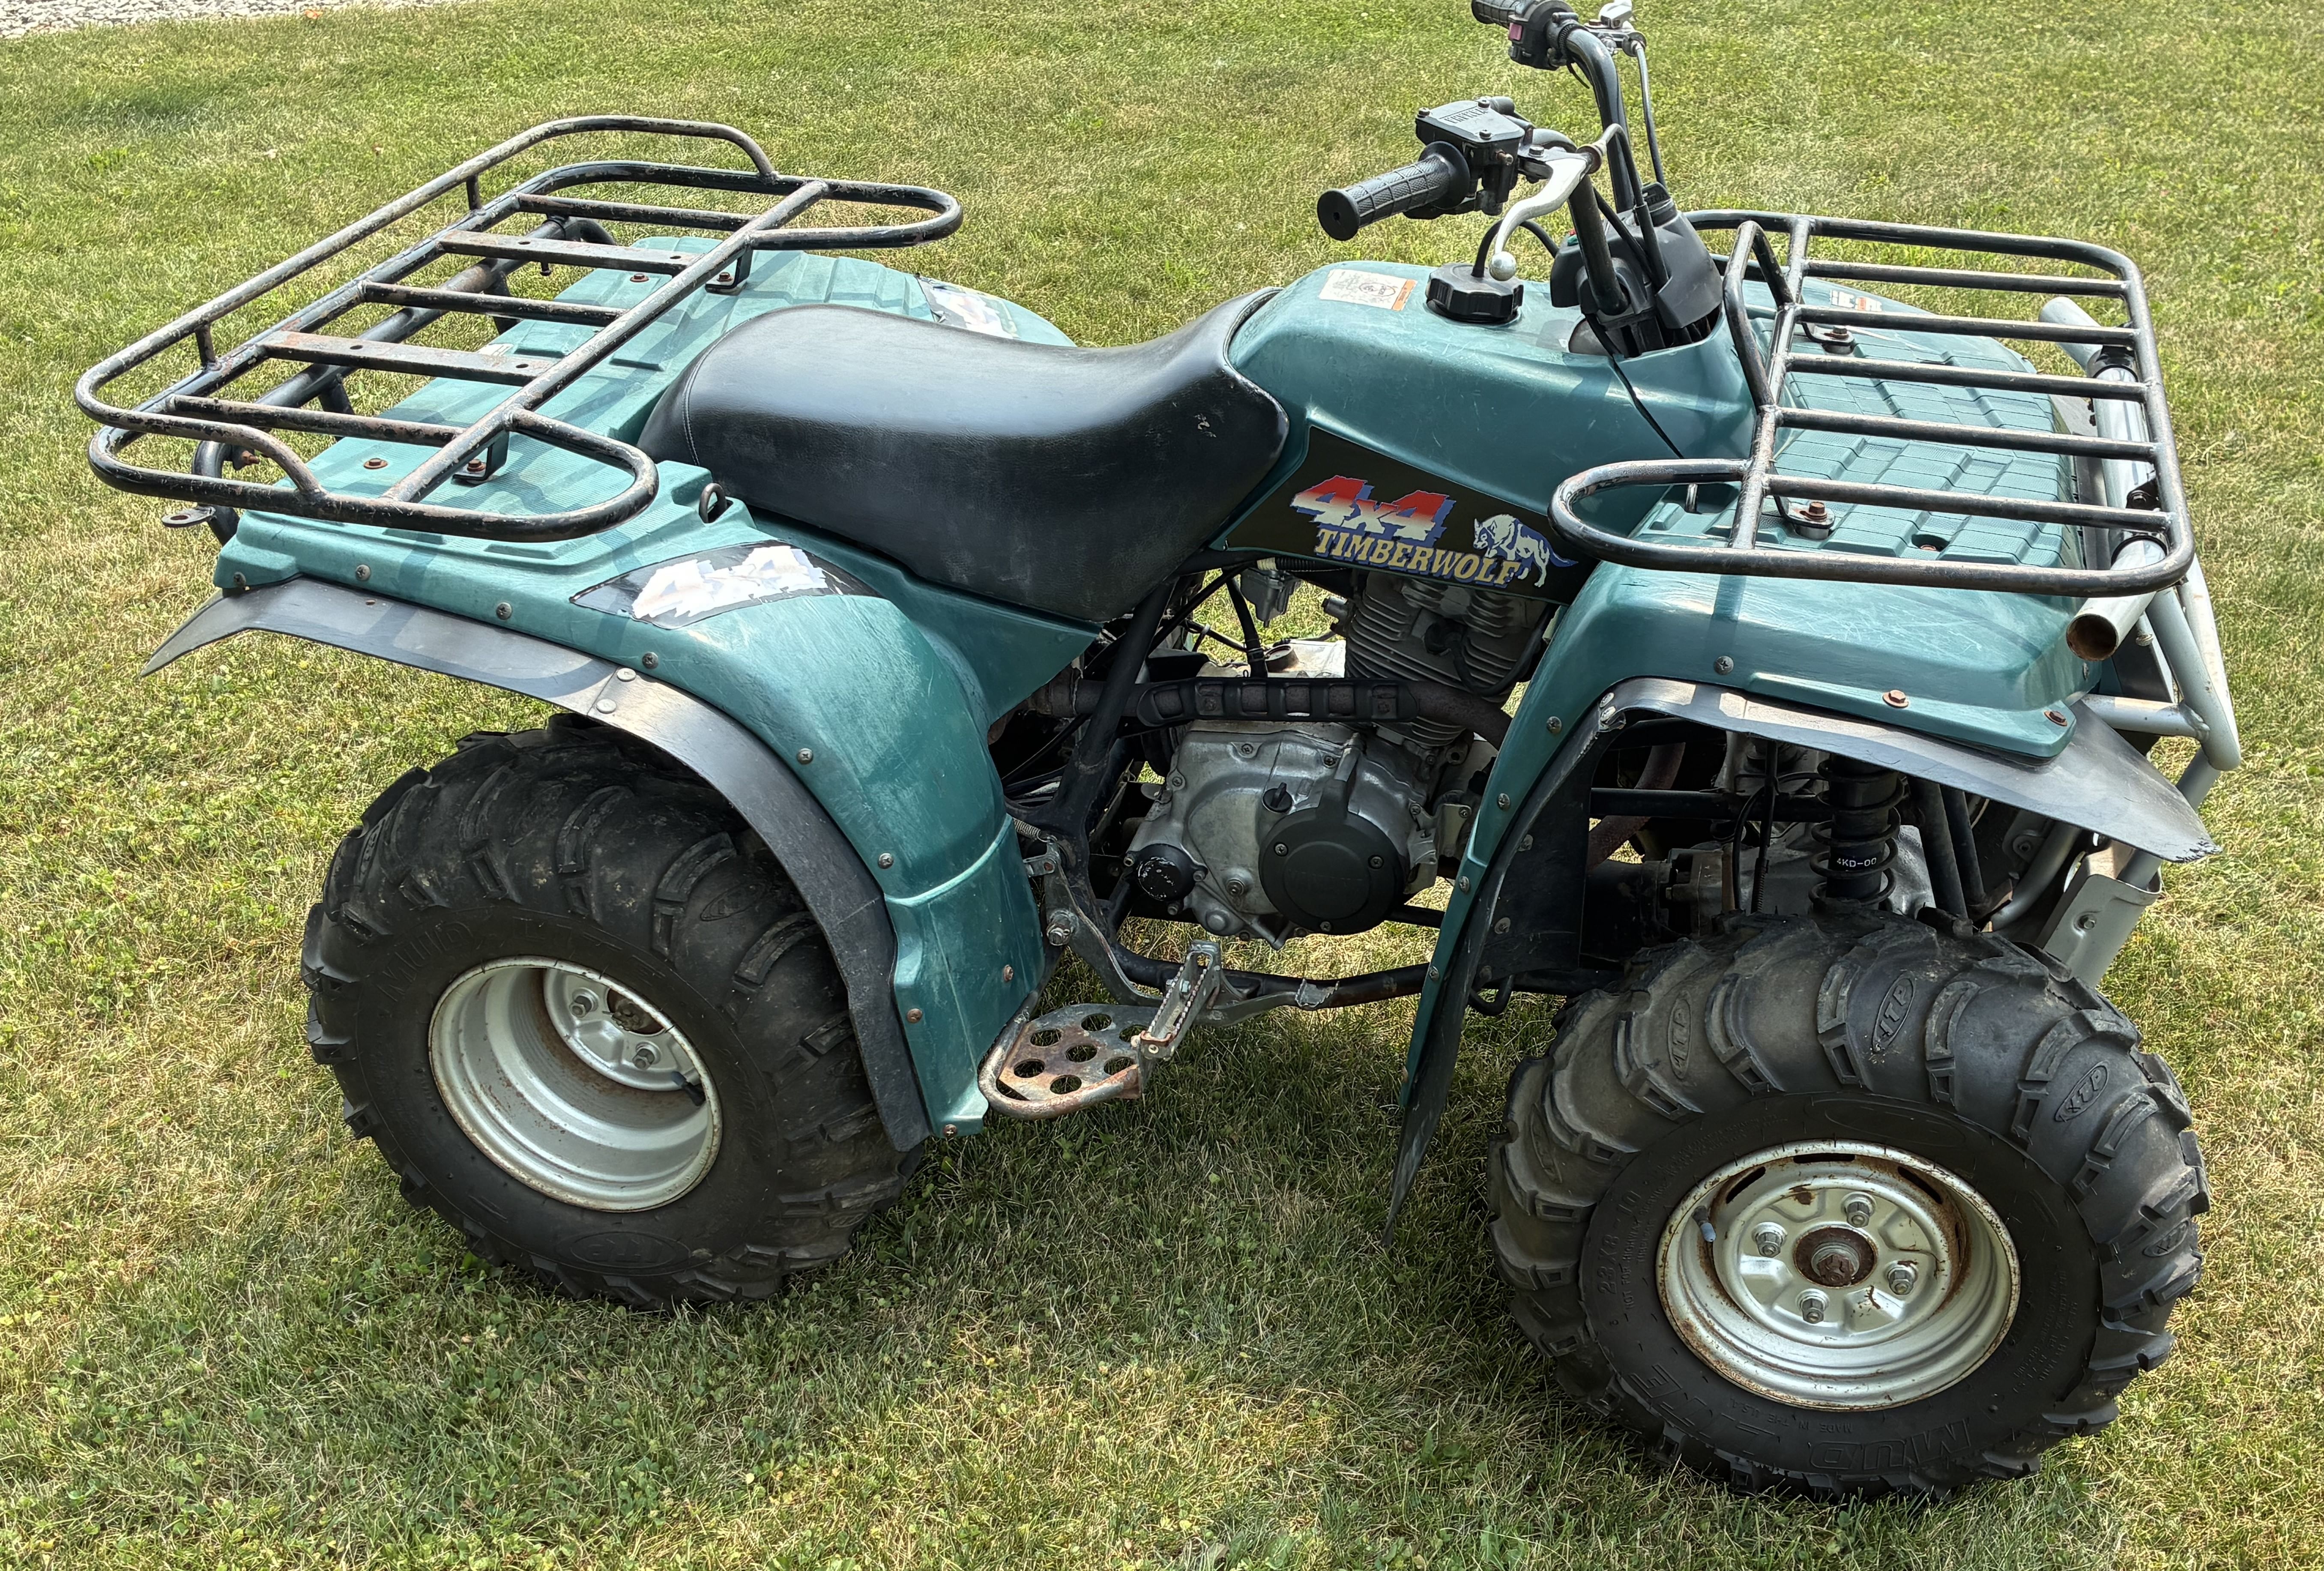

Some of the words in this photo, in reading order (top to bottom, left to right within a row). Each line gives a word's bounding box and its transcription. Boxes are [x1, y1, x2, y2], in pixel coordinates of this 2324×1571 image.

[1291, 475, 1455, 545] 4x4
[1315, 528, 1521, 588] TIMBERWOLF
[1836, 857, 1877, 868] 4KD-00
[1621, 1267, 1633, 1286] FOR
[1767, 1413, 1790, 1427] THE
[1798, 1420, 1810, 1431] IN
[1819, 1422, 1853, 1434] MADE
[1810, 1418, 1972, 1470] MUD
